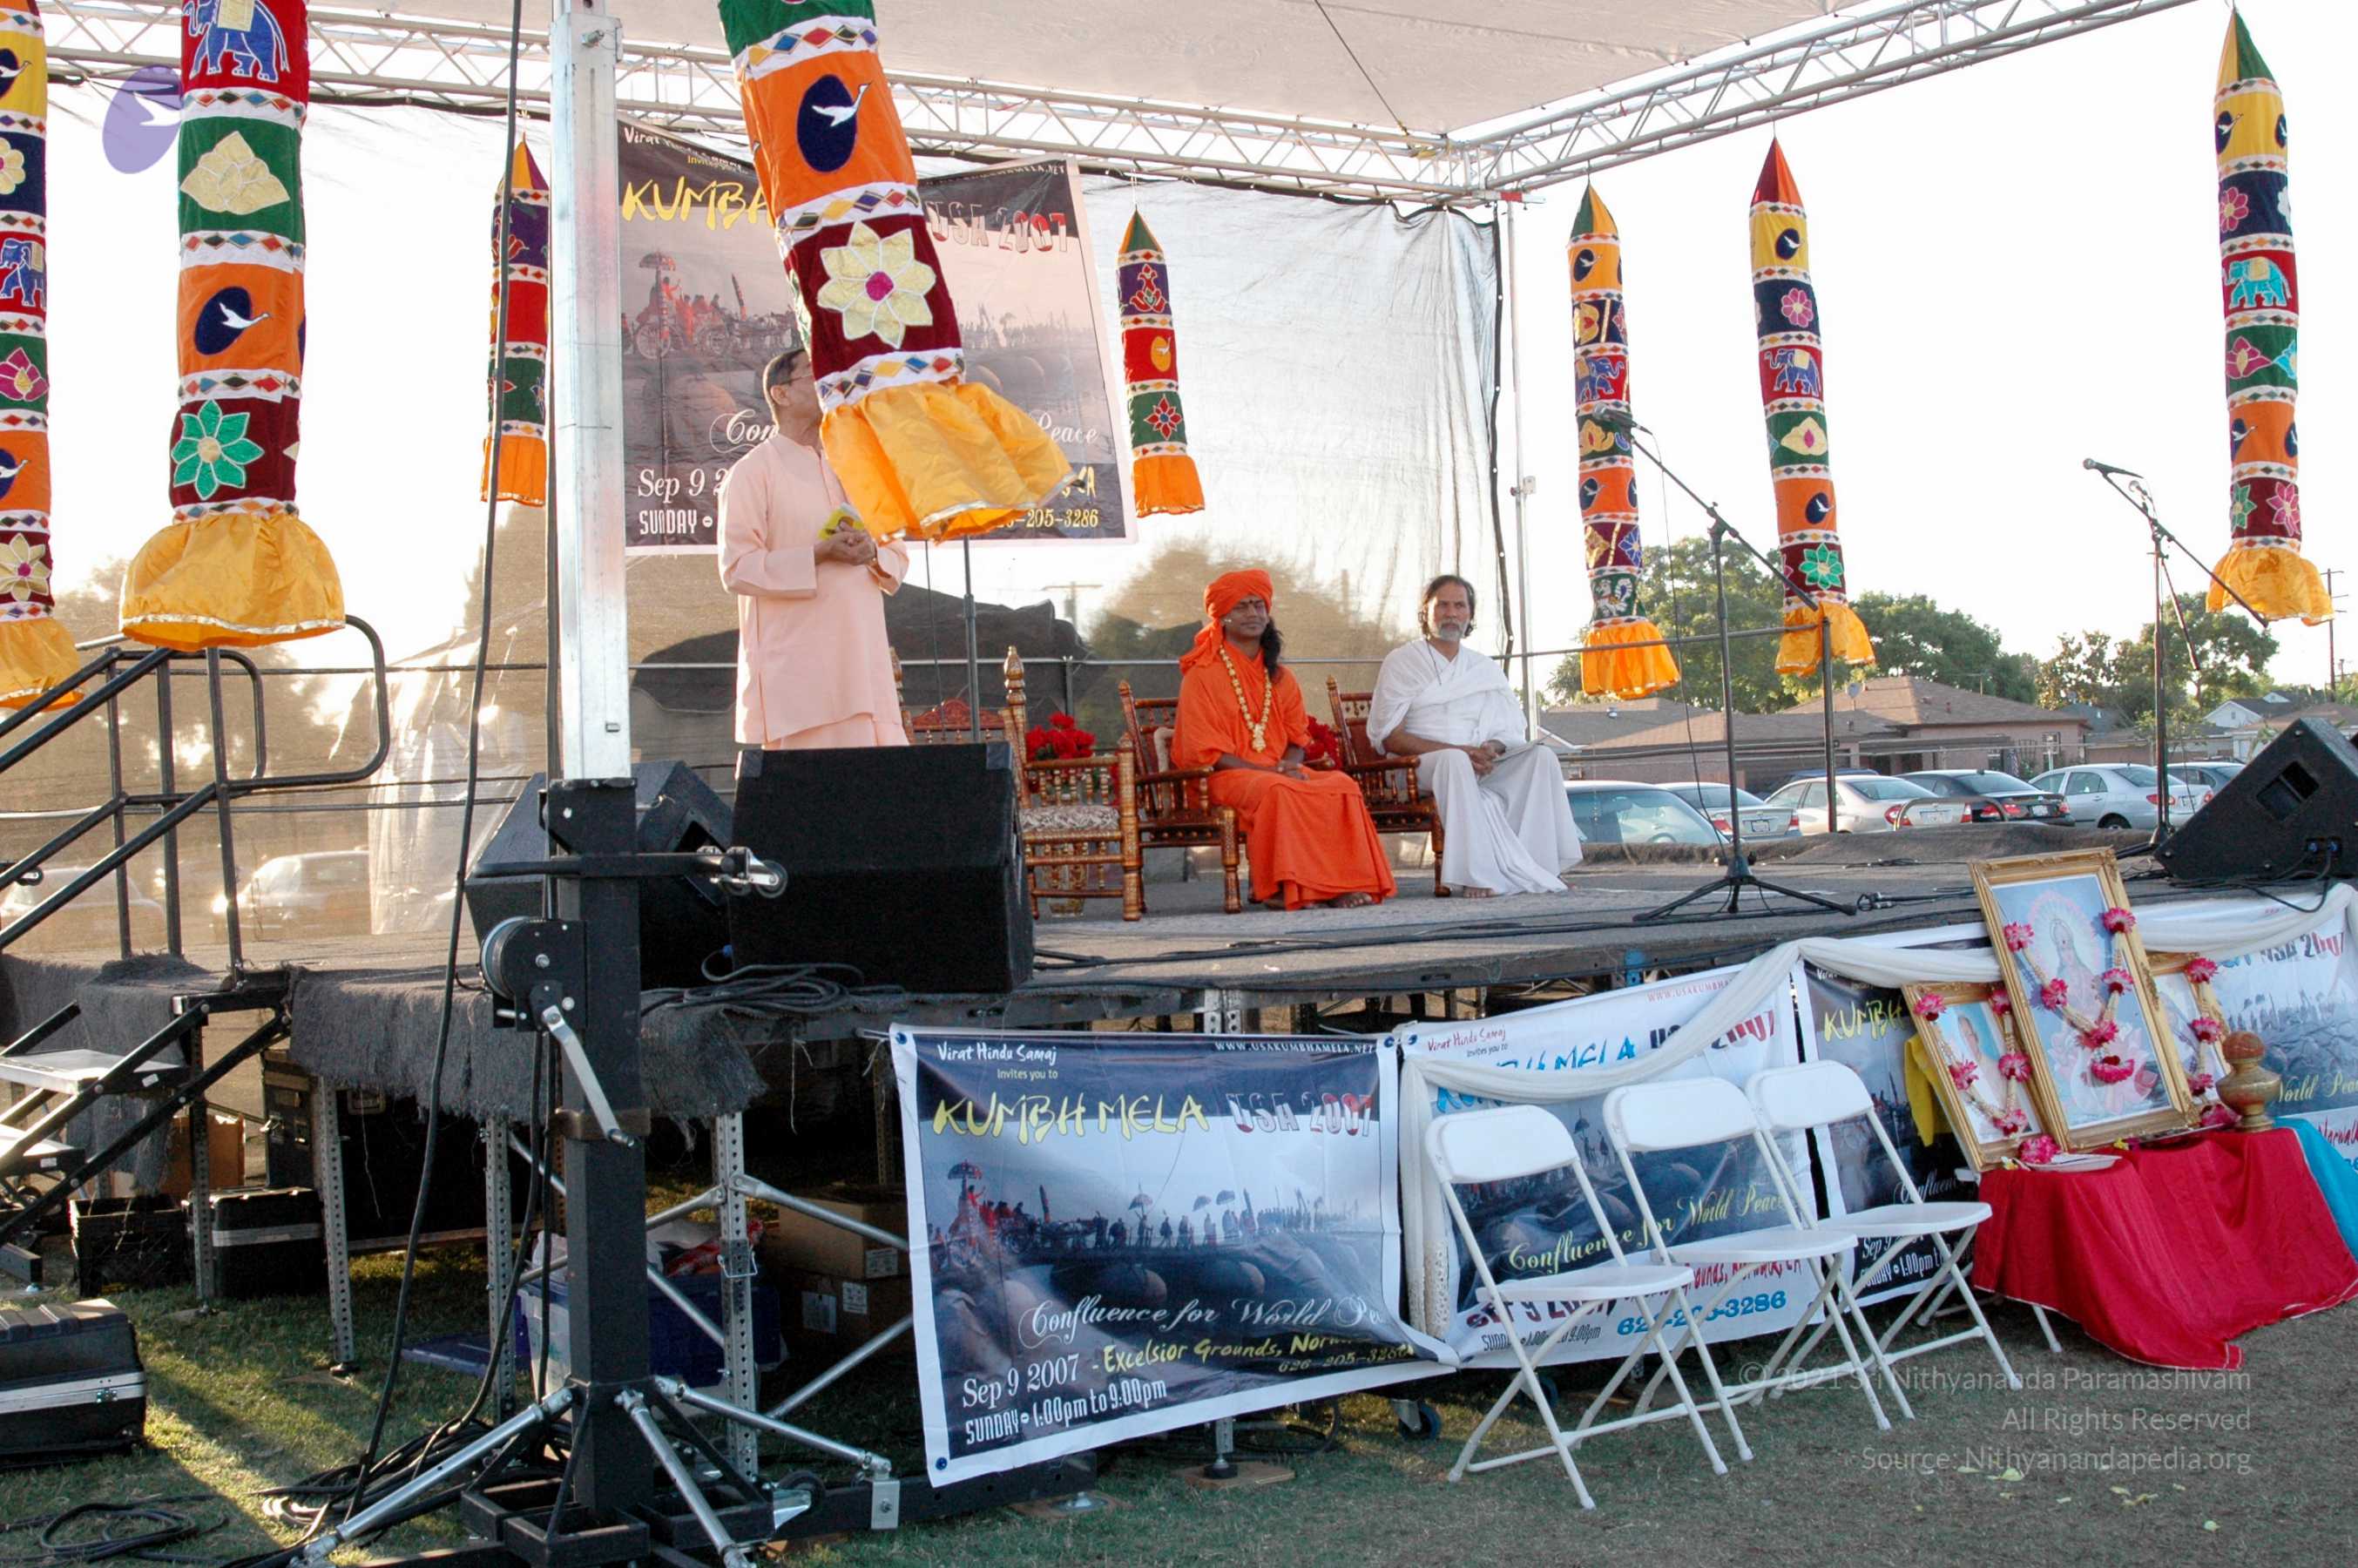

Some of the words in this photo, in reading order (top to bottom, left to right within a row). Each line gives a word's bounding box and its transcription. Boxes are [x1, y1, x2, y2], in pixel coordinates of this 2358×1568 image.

[925, 200, 990, 247] USA
[996, 206, 1068, 253] 2007
[638, 468, 680, 504] Sep
[688, 468, 706, 497] 9
[639, 509, 698, 535] SUNDAY
[1823, 997, 1906, 1043] KUMBH
[937, 1041, 973, 1061] Virat
[976, 1041, 1013, 1061] Hindu
[1016, 1044, 1057, 1065] Samaj
[1214, 1041, 1375, 1054] WWW.USAKUMBHAMELA.NET
[997, 1068, 1028, 1079] Invites
[1030, 1070, 1046, 1081] you
[1048, 1069, 1058, 1079] to
[933, 1092, 1086, 1146] KUMBH
[1098, 1093, 1210, 1142] MELA
[1226, 1092, 1301, 1133] USA
[1301, 1091, 1373, 1136] 2007
[1505, 1229, 1635, 1274] Confluene
[1677, 1186, 1735, 1227] World
[1898, 1252, 1935, 1279] 1:00pm
[1018, 1294, 1170, 1349] Confluence
[1159, 1298, 1219, 1333] for
[1232, 1298, 1332, 1327] World
[963, 1377, 1002, 1409] Sep
[1007, 1367, 1020, 1396] 9
[1026, 1353, 1080, 1393] 2007
[1103, 1339, 1188, 1373] Excelsior
[1193, 1336, 1283, 1365] Grounds,
[965, 1409, 1020, 1445] SUNDAY
[1032, 1396, 1088, 1429] 1:00pm
[1090, 1388, 1108, 1415] to
[1109, 1378, 1168, 1409] 9:00pm
